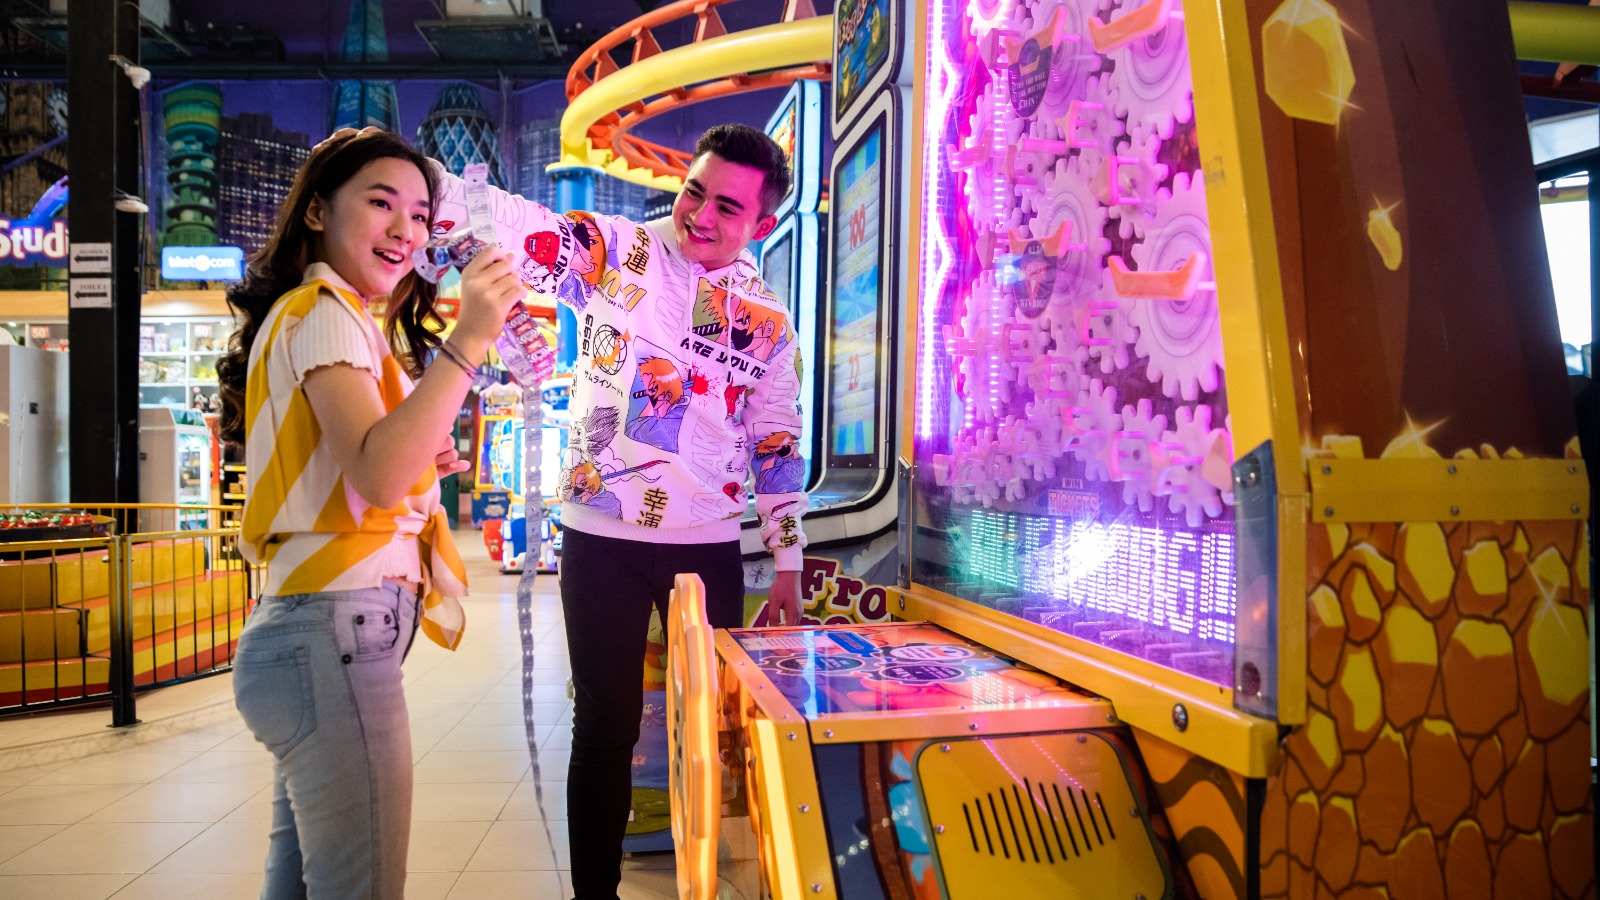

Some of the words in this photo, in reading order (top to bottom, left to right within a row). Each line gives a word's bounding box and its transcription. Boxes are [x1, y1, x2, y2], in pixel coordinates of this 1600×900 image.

[582, 314, 594, 357] 1993
[680, 338, 714, 358] ARE
[716, 351, 749, 372] YOU
[1062, 478, 1083, 489] WIN
